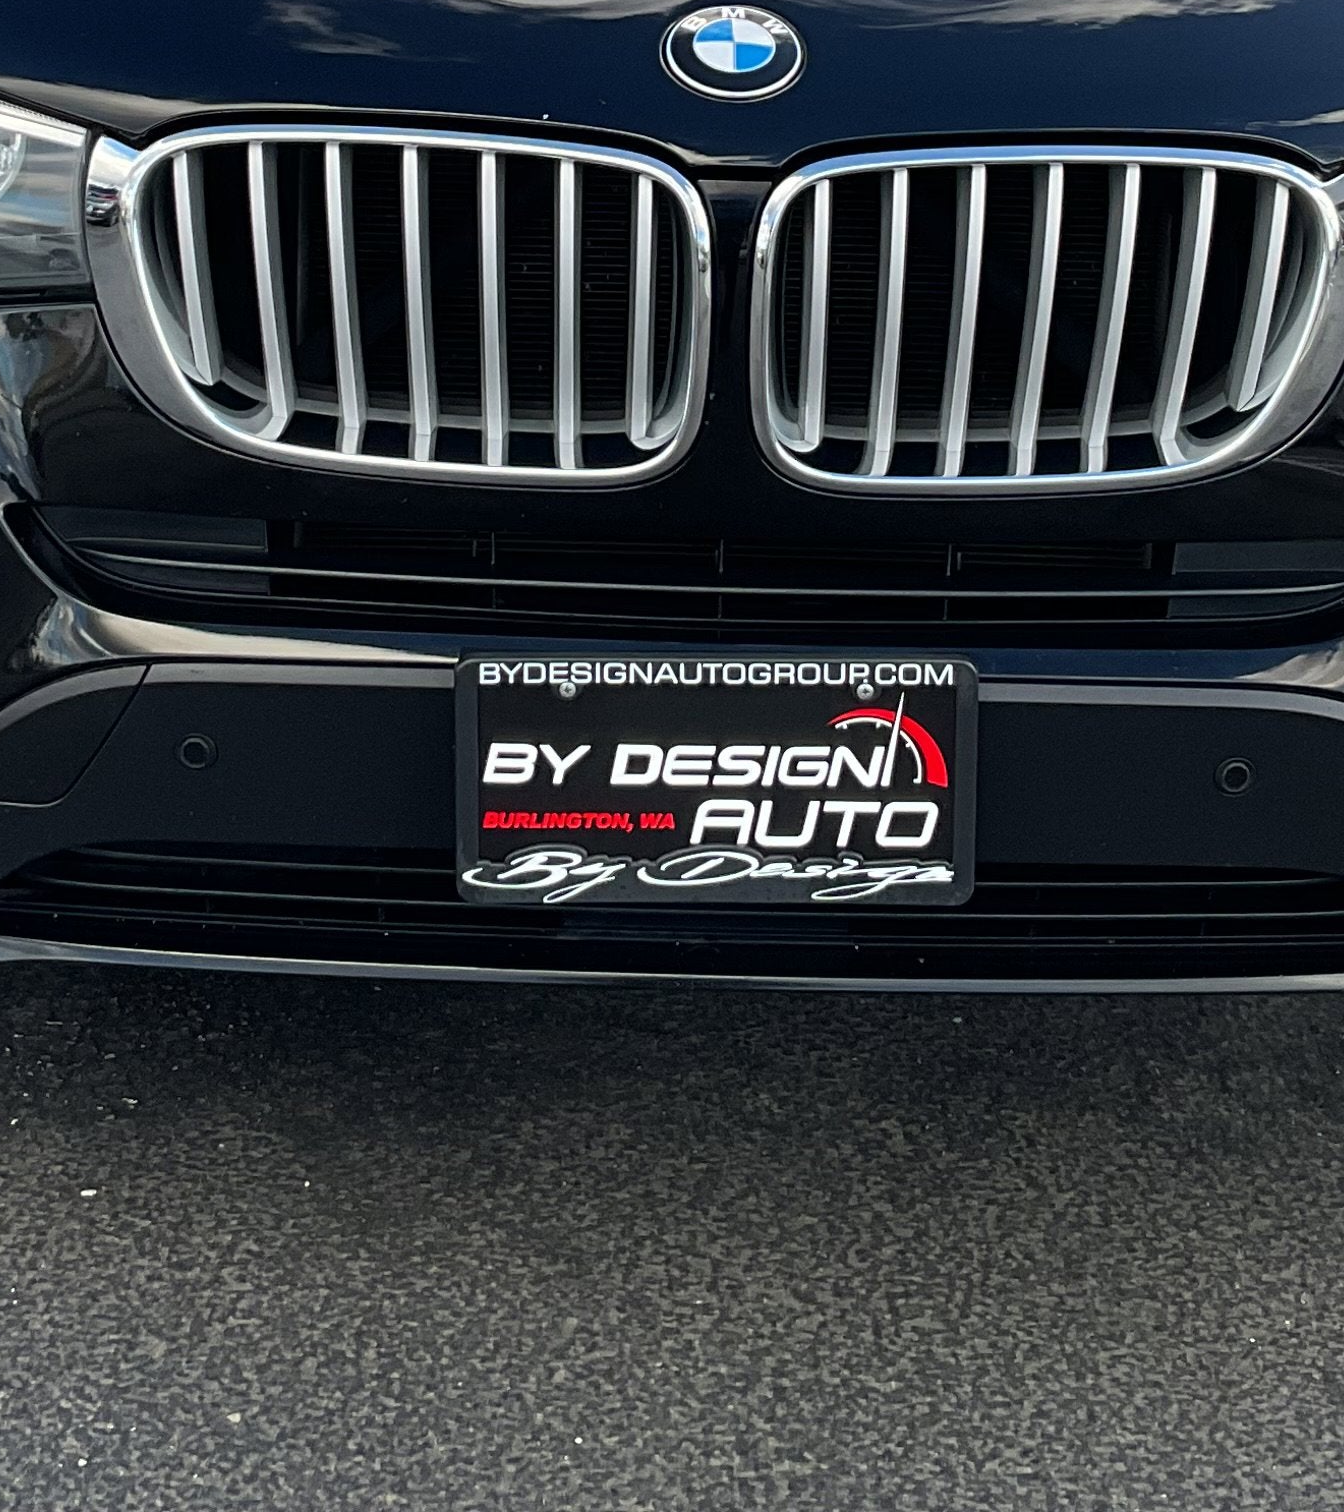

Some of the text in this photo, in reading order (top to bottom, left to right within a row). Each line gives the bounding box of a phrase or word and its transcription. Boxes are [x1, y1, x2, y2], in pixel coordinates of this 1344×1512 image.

[680, 7, 789, 35] BMW
[478, 662, 955, 687] BYDESIGNAUTOGROUP.COM
[482, 742, 592, 785] BY
[482, 811, 676, 833] BURLINGTON, WA
[689, 799, 939, 848] AUTO
[462, 851, 628, 904] By
